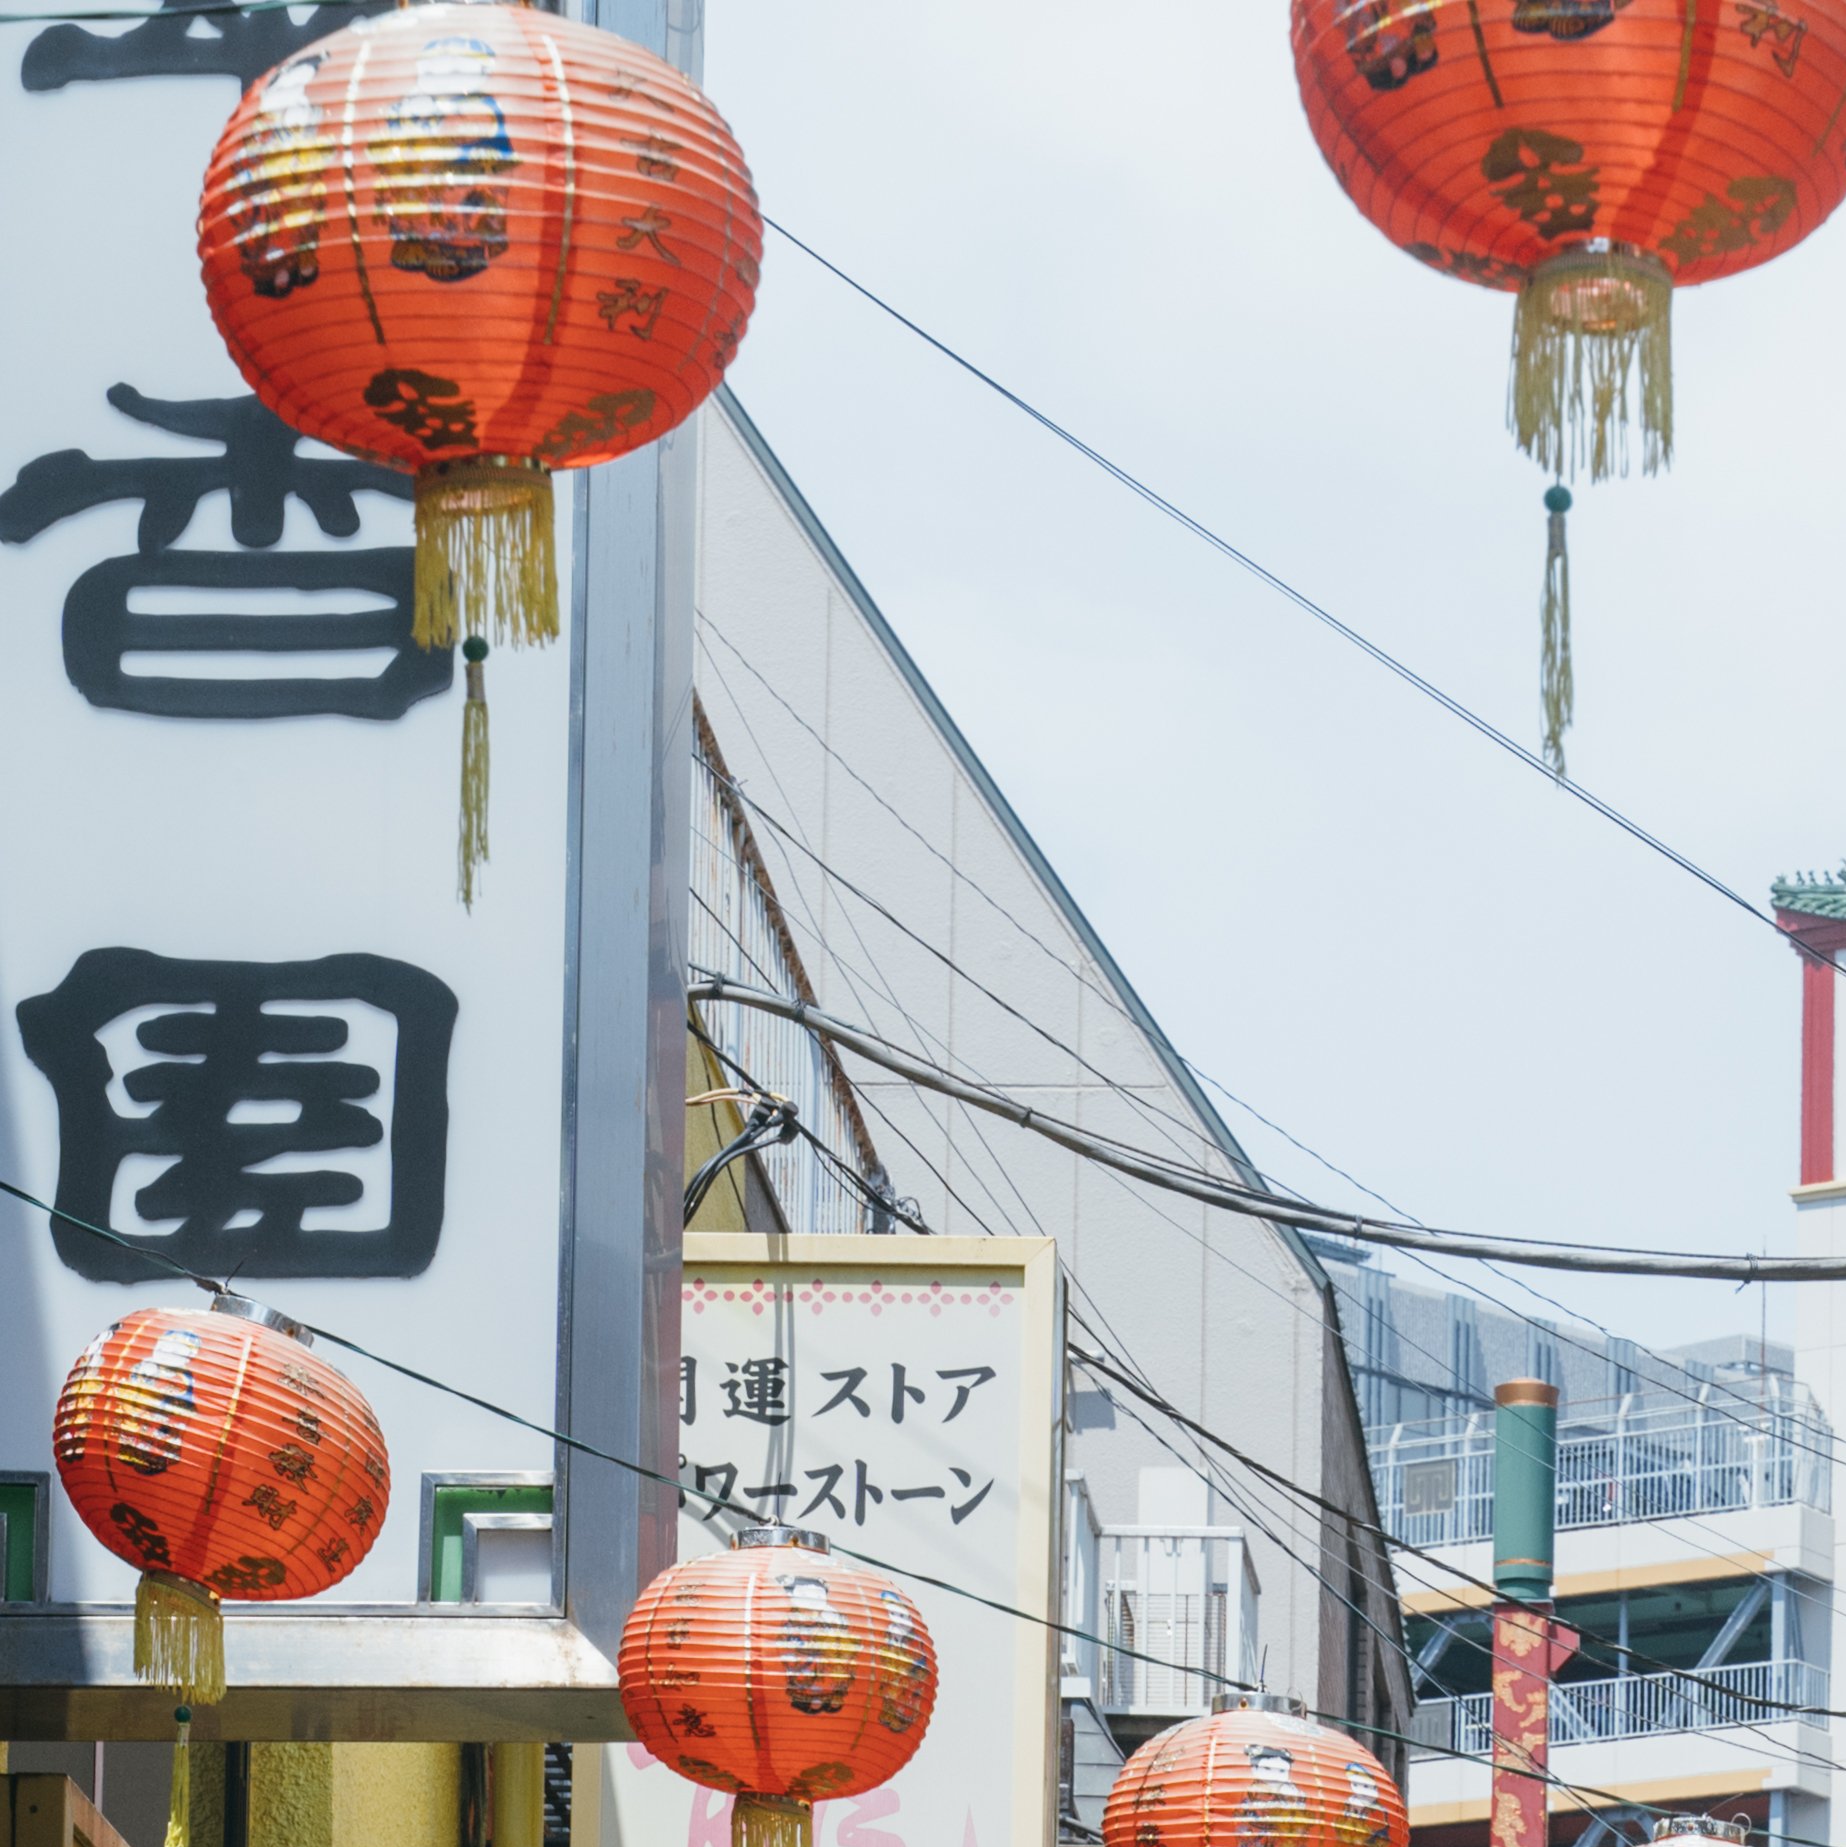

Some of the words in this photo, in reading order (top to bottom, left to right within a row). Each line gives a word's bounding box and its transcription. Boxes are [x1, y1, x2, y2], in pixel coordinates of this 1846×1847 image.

[0, 0, 460, 1281] 香園
[679, 1357, 997, 1426] 運ストア
[678, 1453, 995, 1527] ワーストーン
